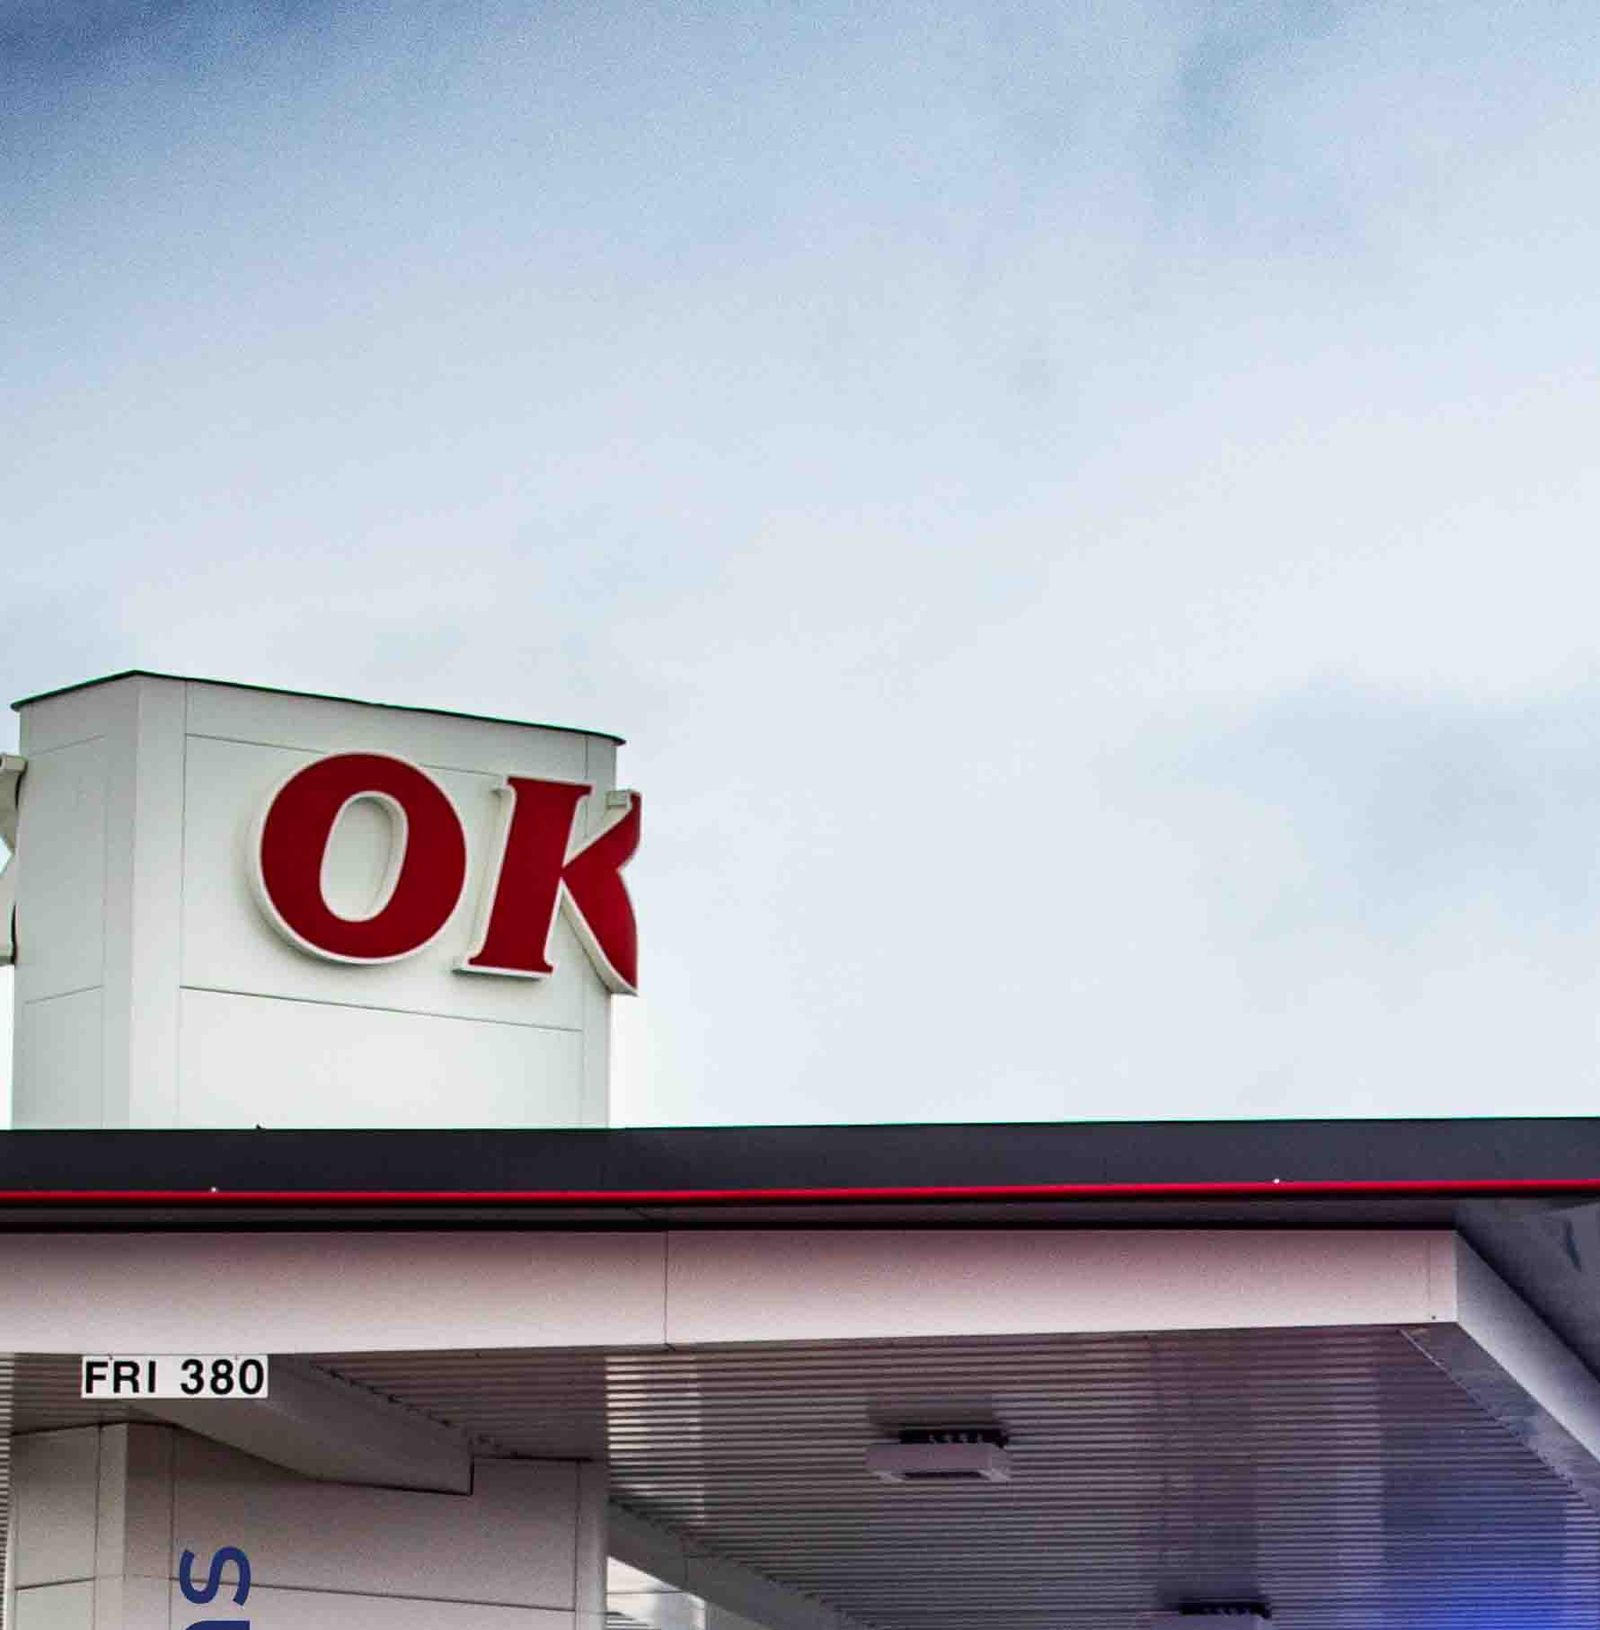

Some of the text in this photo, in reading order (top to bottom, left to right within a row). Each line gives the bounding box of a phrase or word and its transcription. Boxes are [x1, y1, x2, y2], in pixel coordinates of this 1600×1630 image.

[258, 751, 642, 996] OK
[85, 1358, 264, 1395] FRI 380
